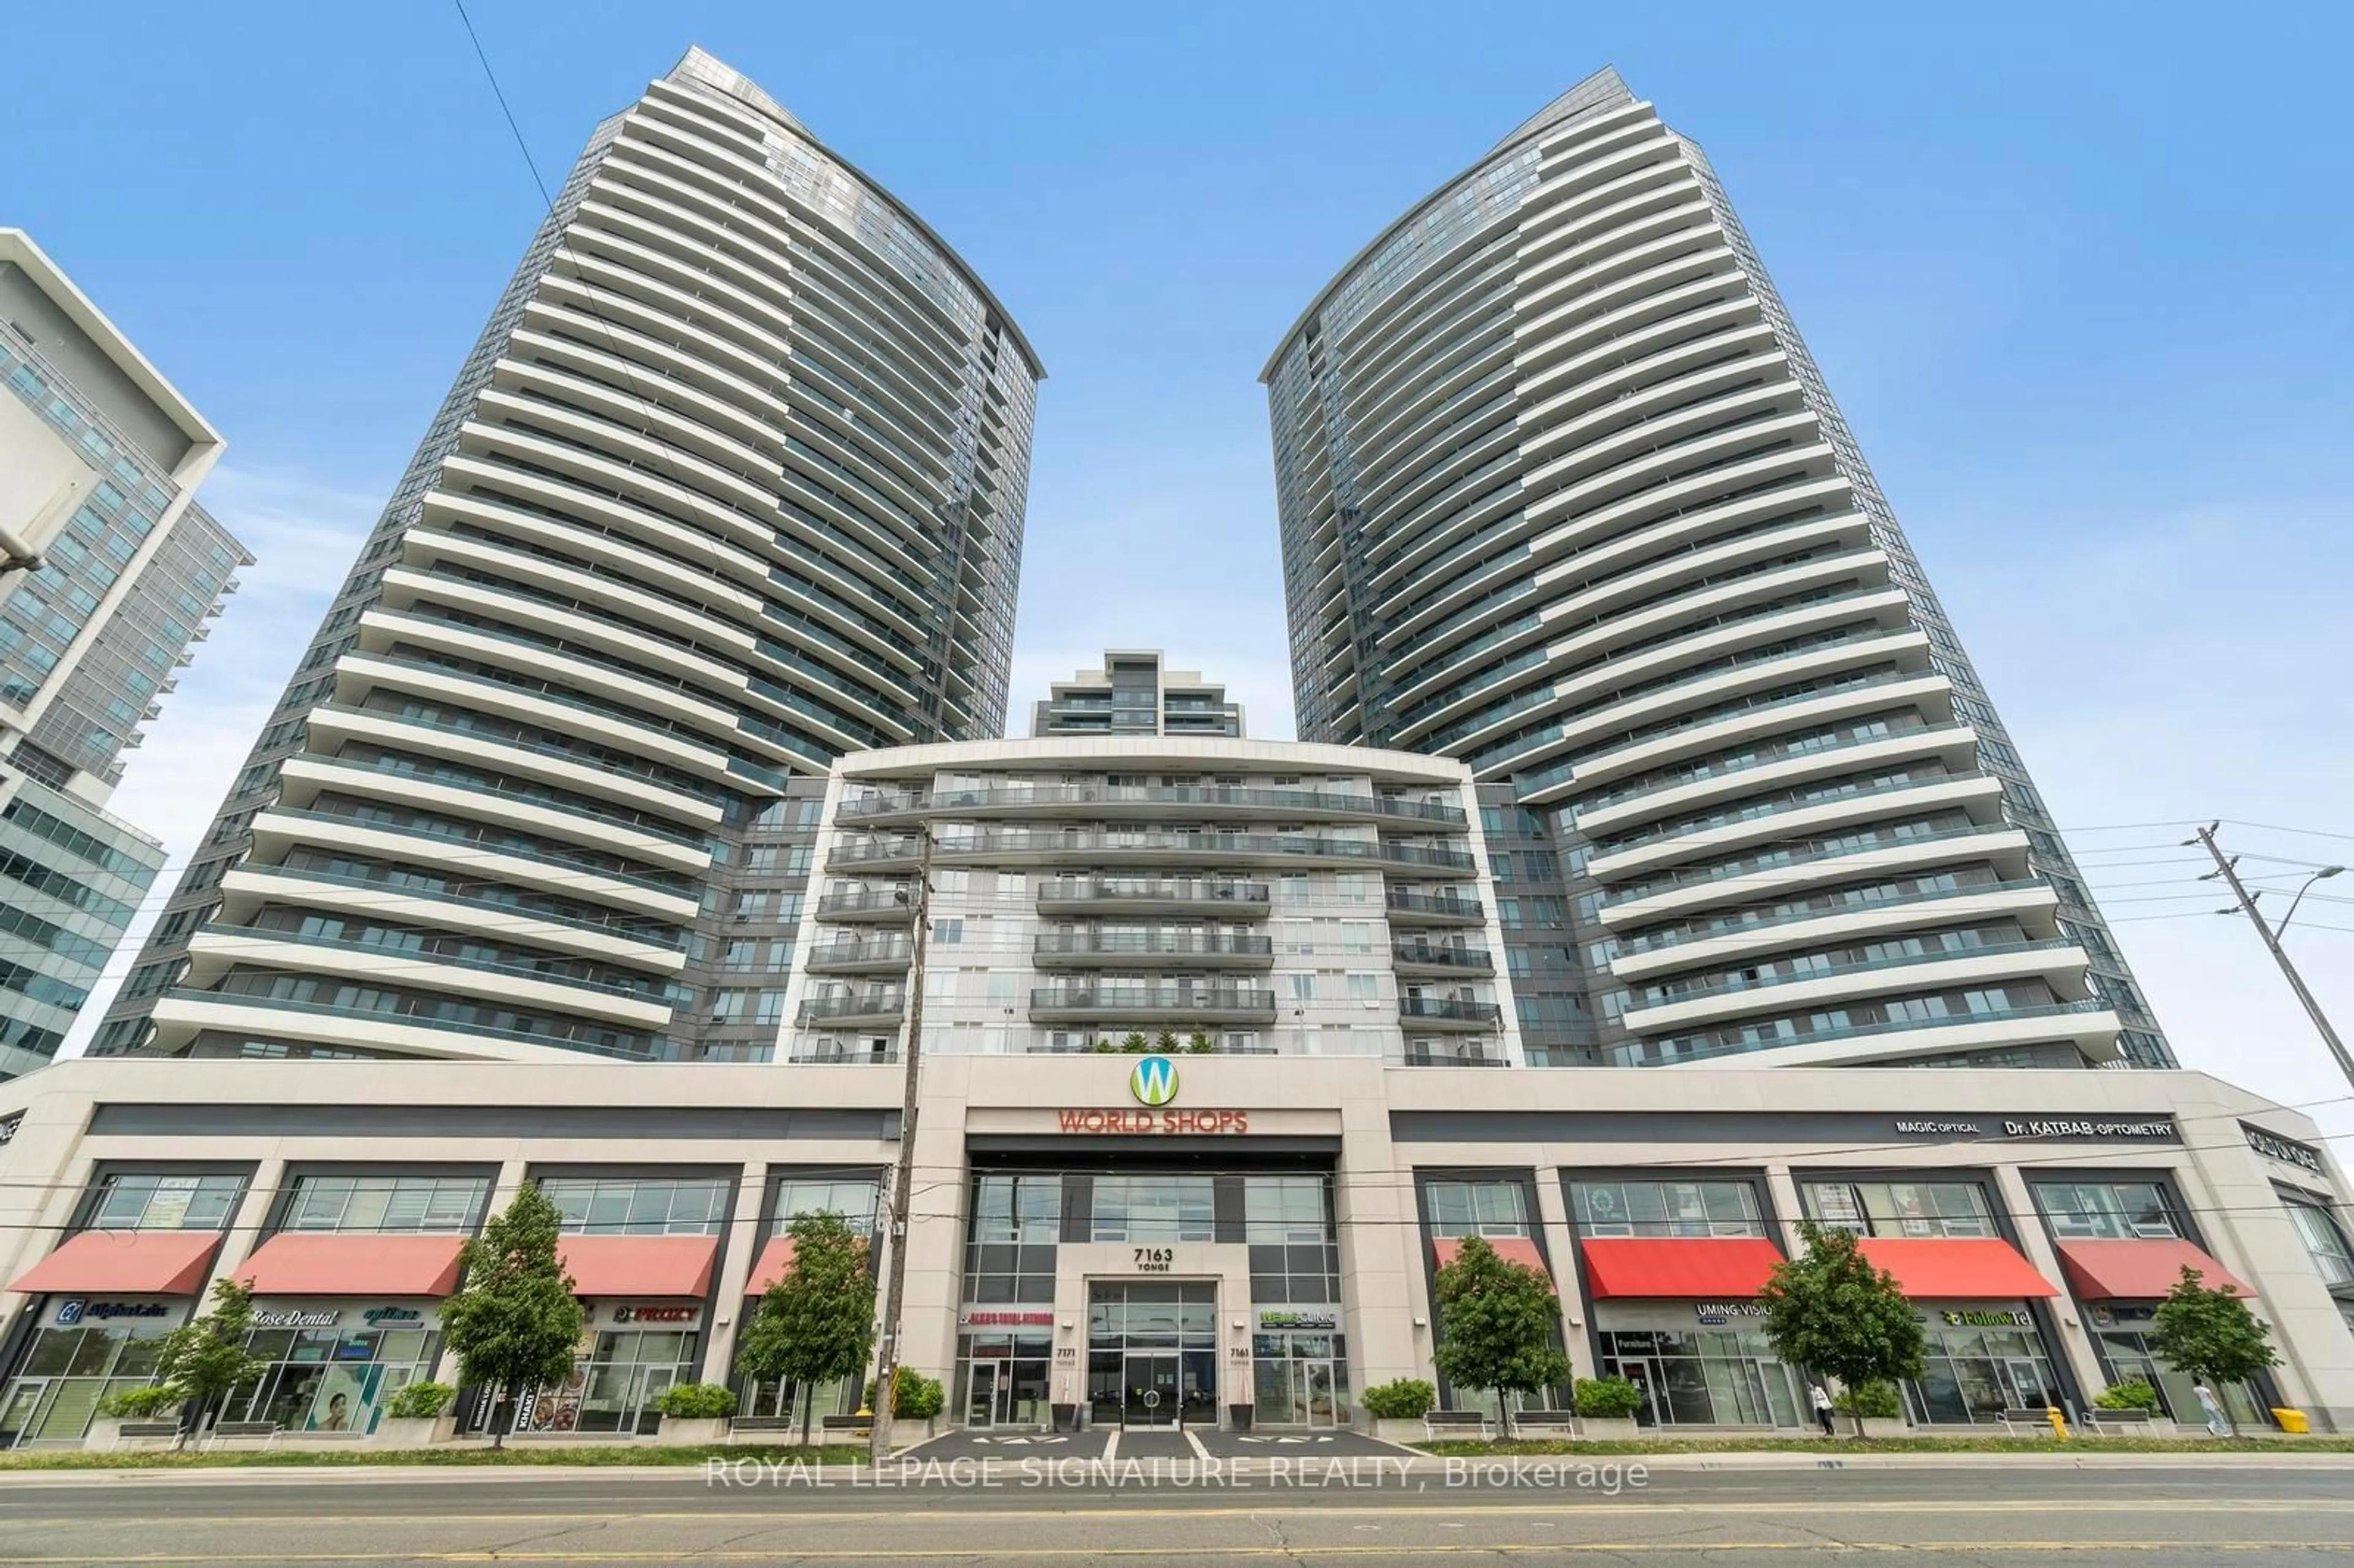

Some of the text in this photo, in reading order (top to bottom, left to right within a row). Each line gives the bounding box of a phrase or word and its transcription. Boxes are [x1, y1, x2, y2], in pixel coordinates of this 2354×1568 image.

[1135, 1062, 1175, 1103] W
[1059, 1109, 1248, 1133] WORLD SHOPS
[1897, 1121, 1980, 1133] MAGIC OPTICAL
[2005, 1121, 2173, 1136] Dr. KATBAB OPTOMETRY
[1134, 1248, 1173, 1262] 7163
[1138, 1263, 1170, 1272] YONGE
[634, 1306, 699, 1322] PROXY
[1057, 1348, 1076, 1358] 7171
[1230, 1348, 1249, 1358] 7161
[519, 1395, 535, 1428] KHAKI
